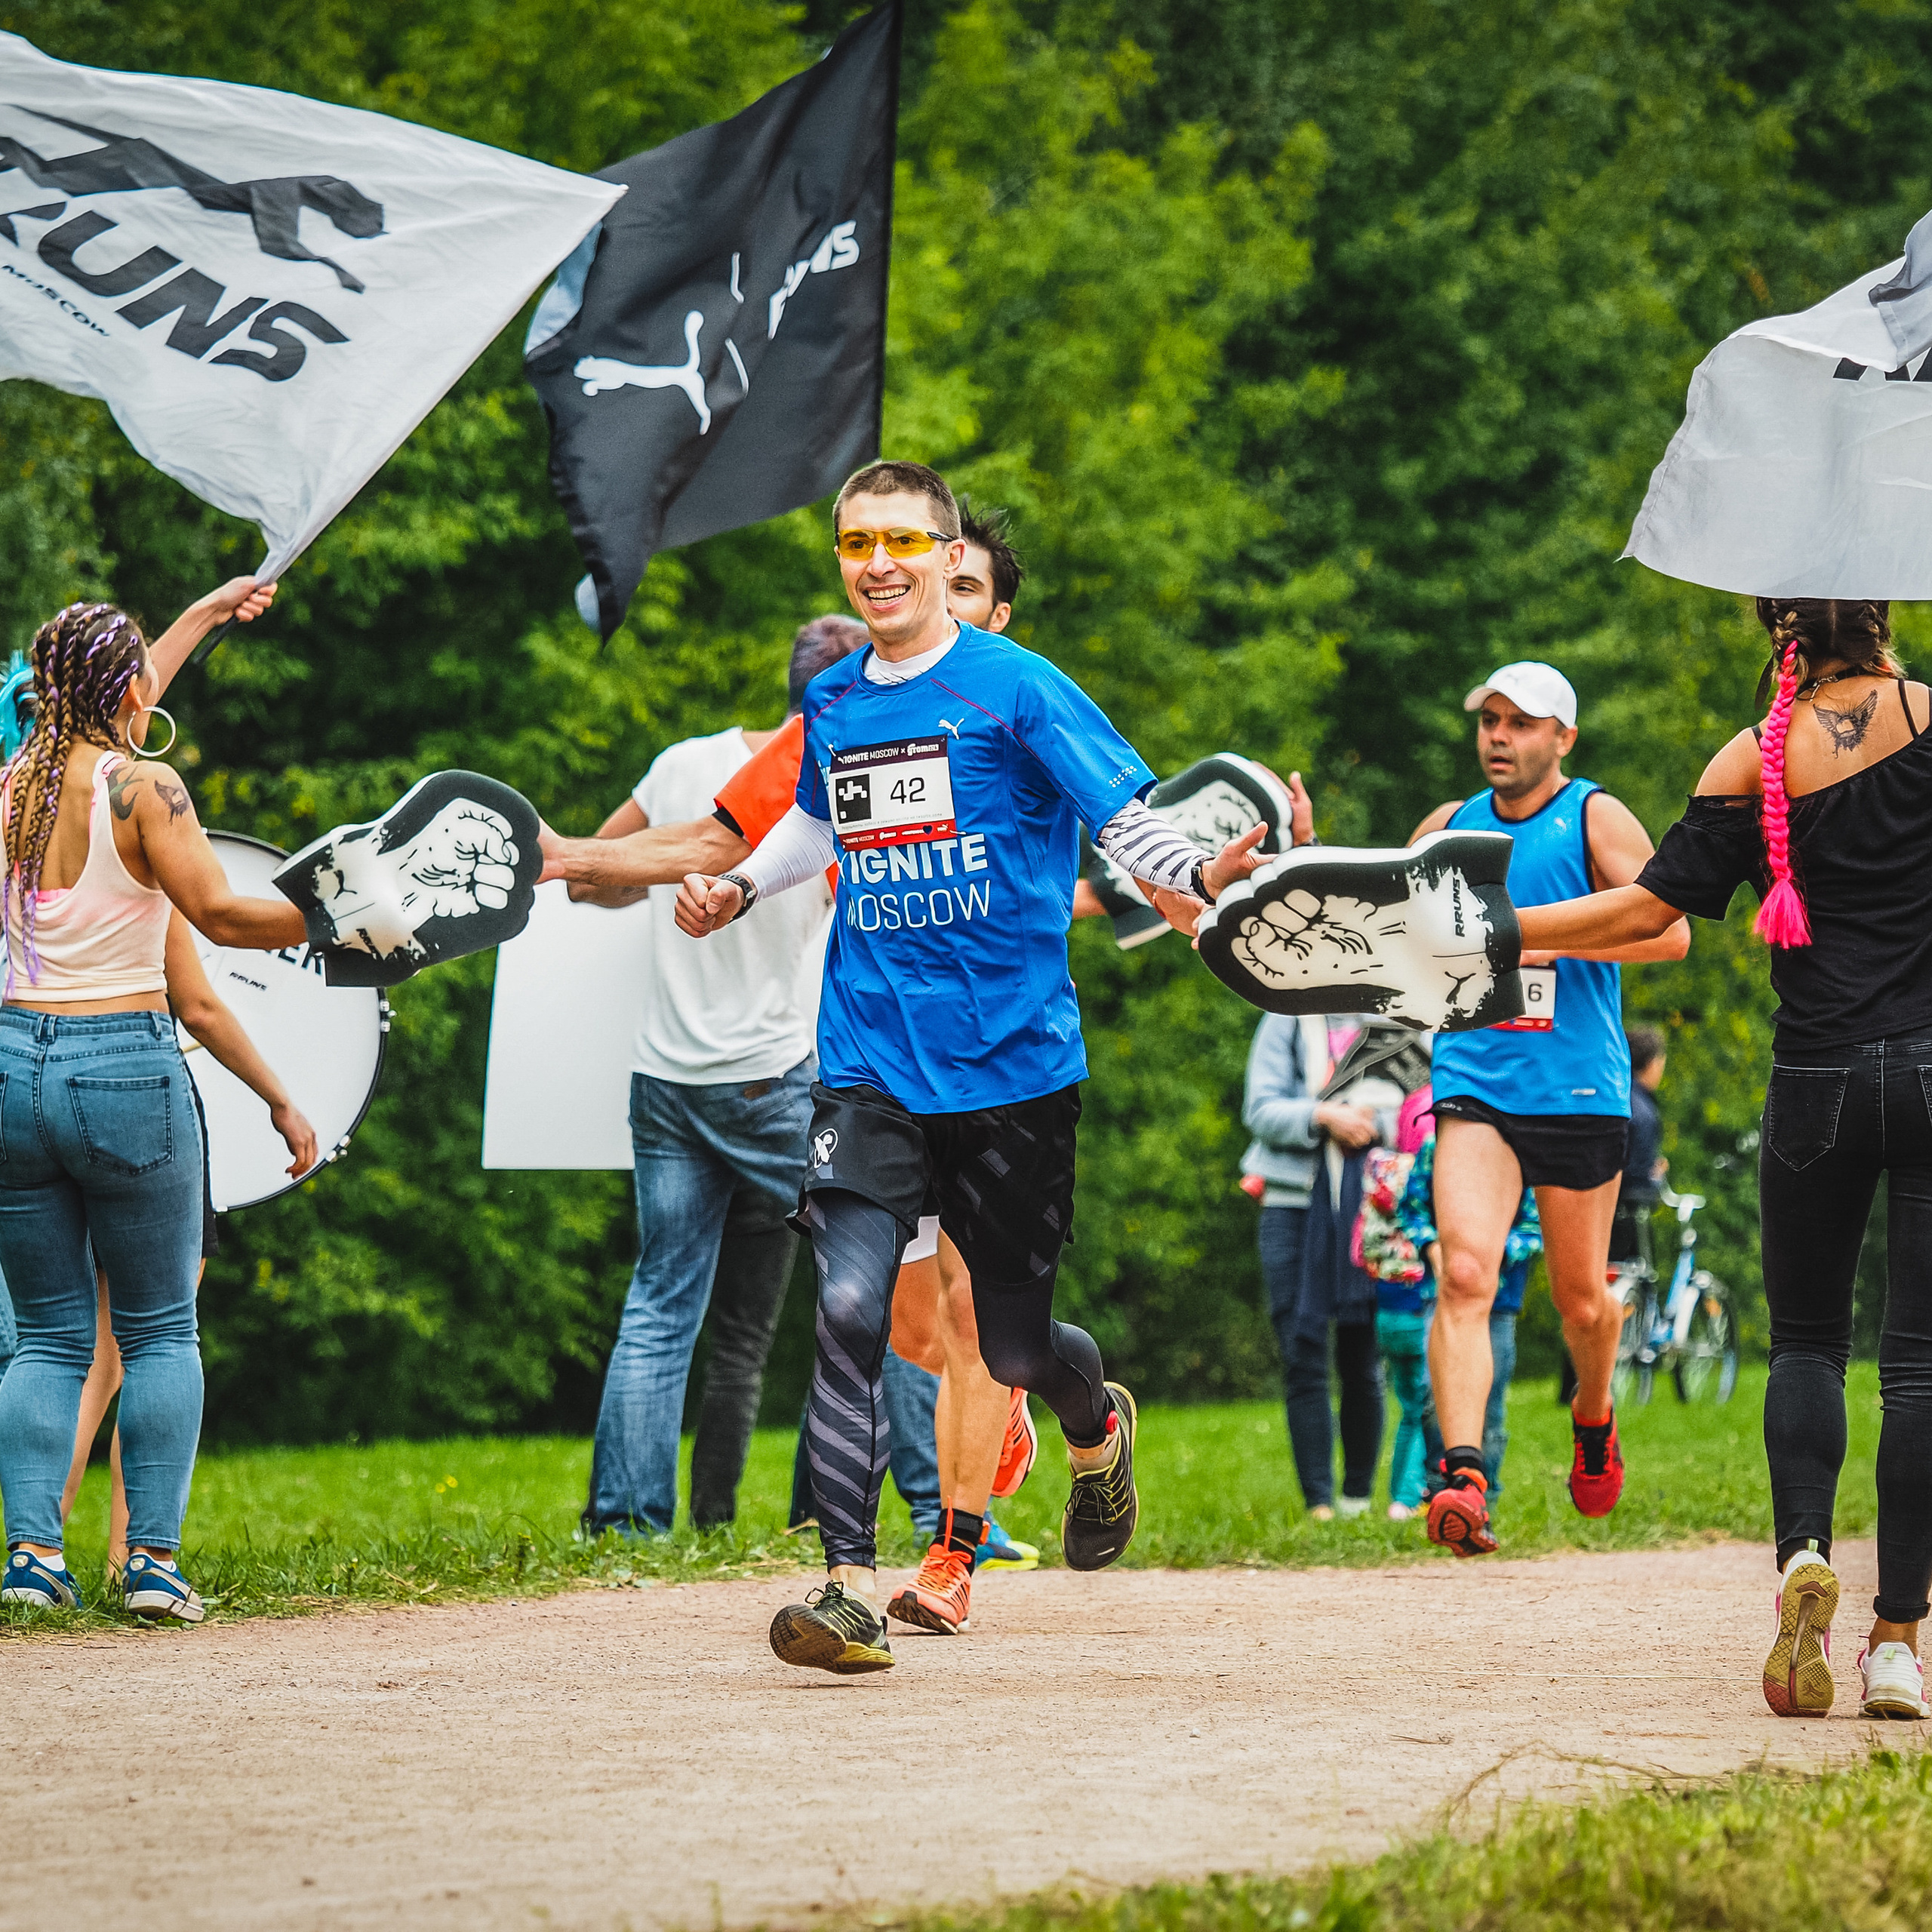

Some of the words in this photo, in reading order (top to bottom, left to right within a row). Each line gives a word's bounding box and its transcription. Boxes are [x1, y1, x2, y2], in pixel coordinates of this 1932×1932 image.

[843, 752, 869, 764] IGNITE
[869, 747, 899, 760] MOSCOW
[891, 777, 925, 804] 42
[849, 833, 989, 884] IGNITE
[1453, 877, 1465, 937] RRUNS
[265, 944, 323, 975] ER
